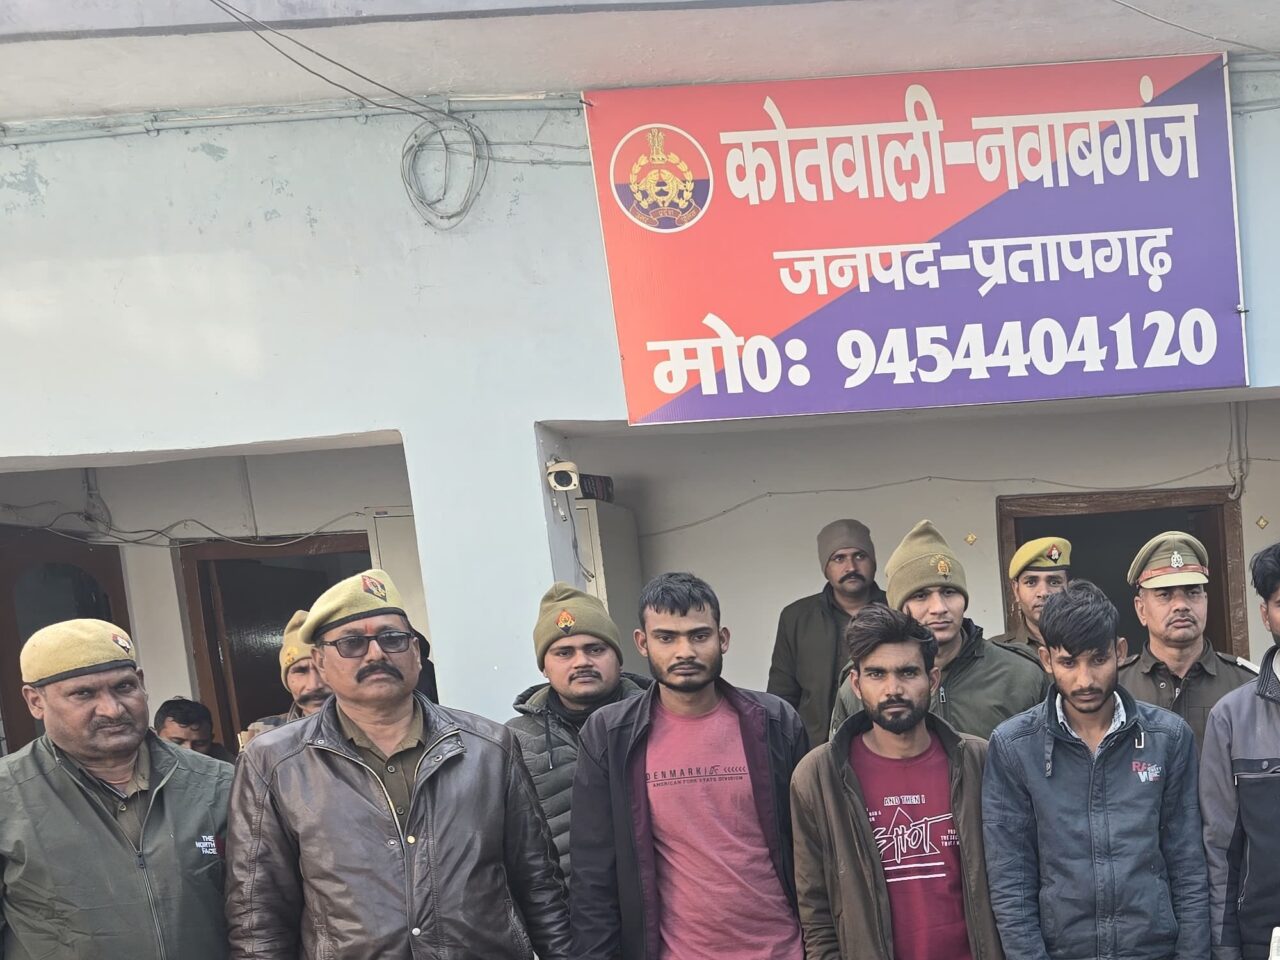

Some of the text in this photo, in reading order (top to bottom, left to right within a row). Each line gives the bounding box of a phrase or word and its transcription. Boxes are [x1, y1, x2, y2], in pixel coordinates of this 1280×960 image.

[719, 74, 1199, 205] कोतवाली-नवाबगंज
[836, 306, 1218, 390] 9454404120
[646, 766, 702, 780] DENMARK
